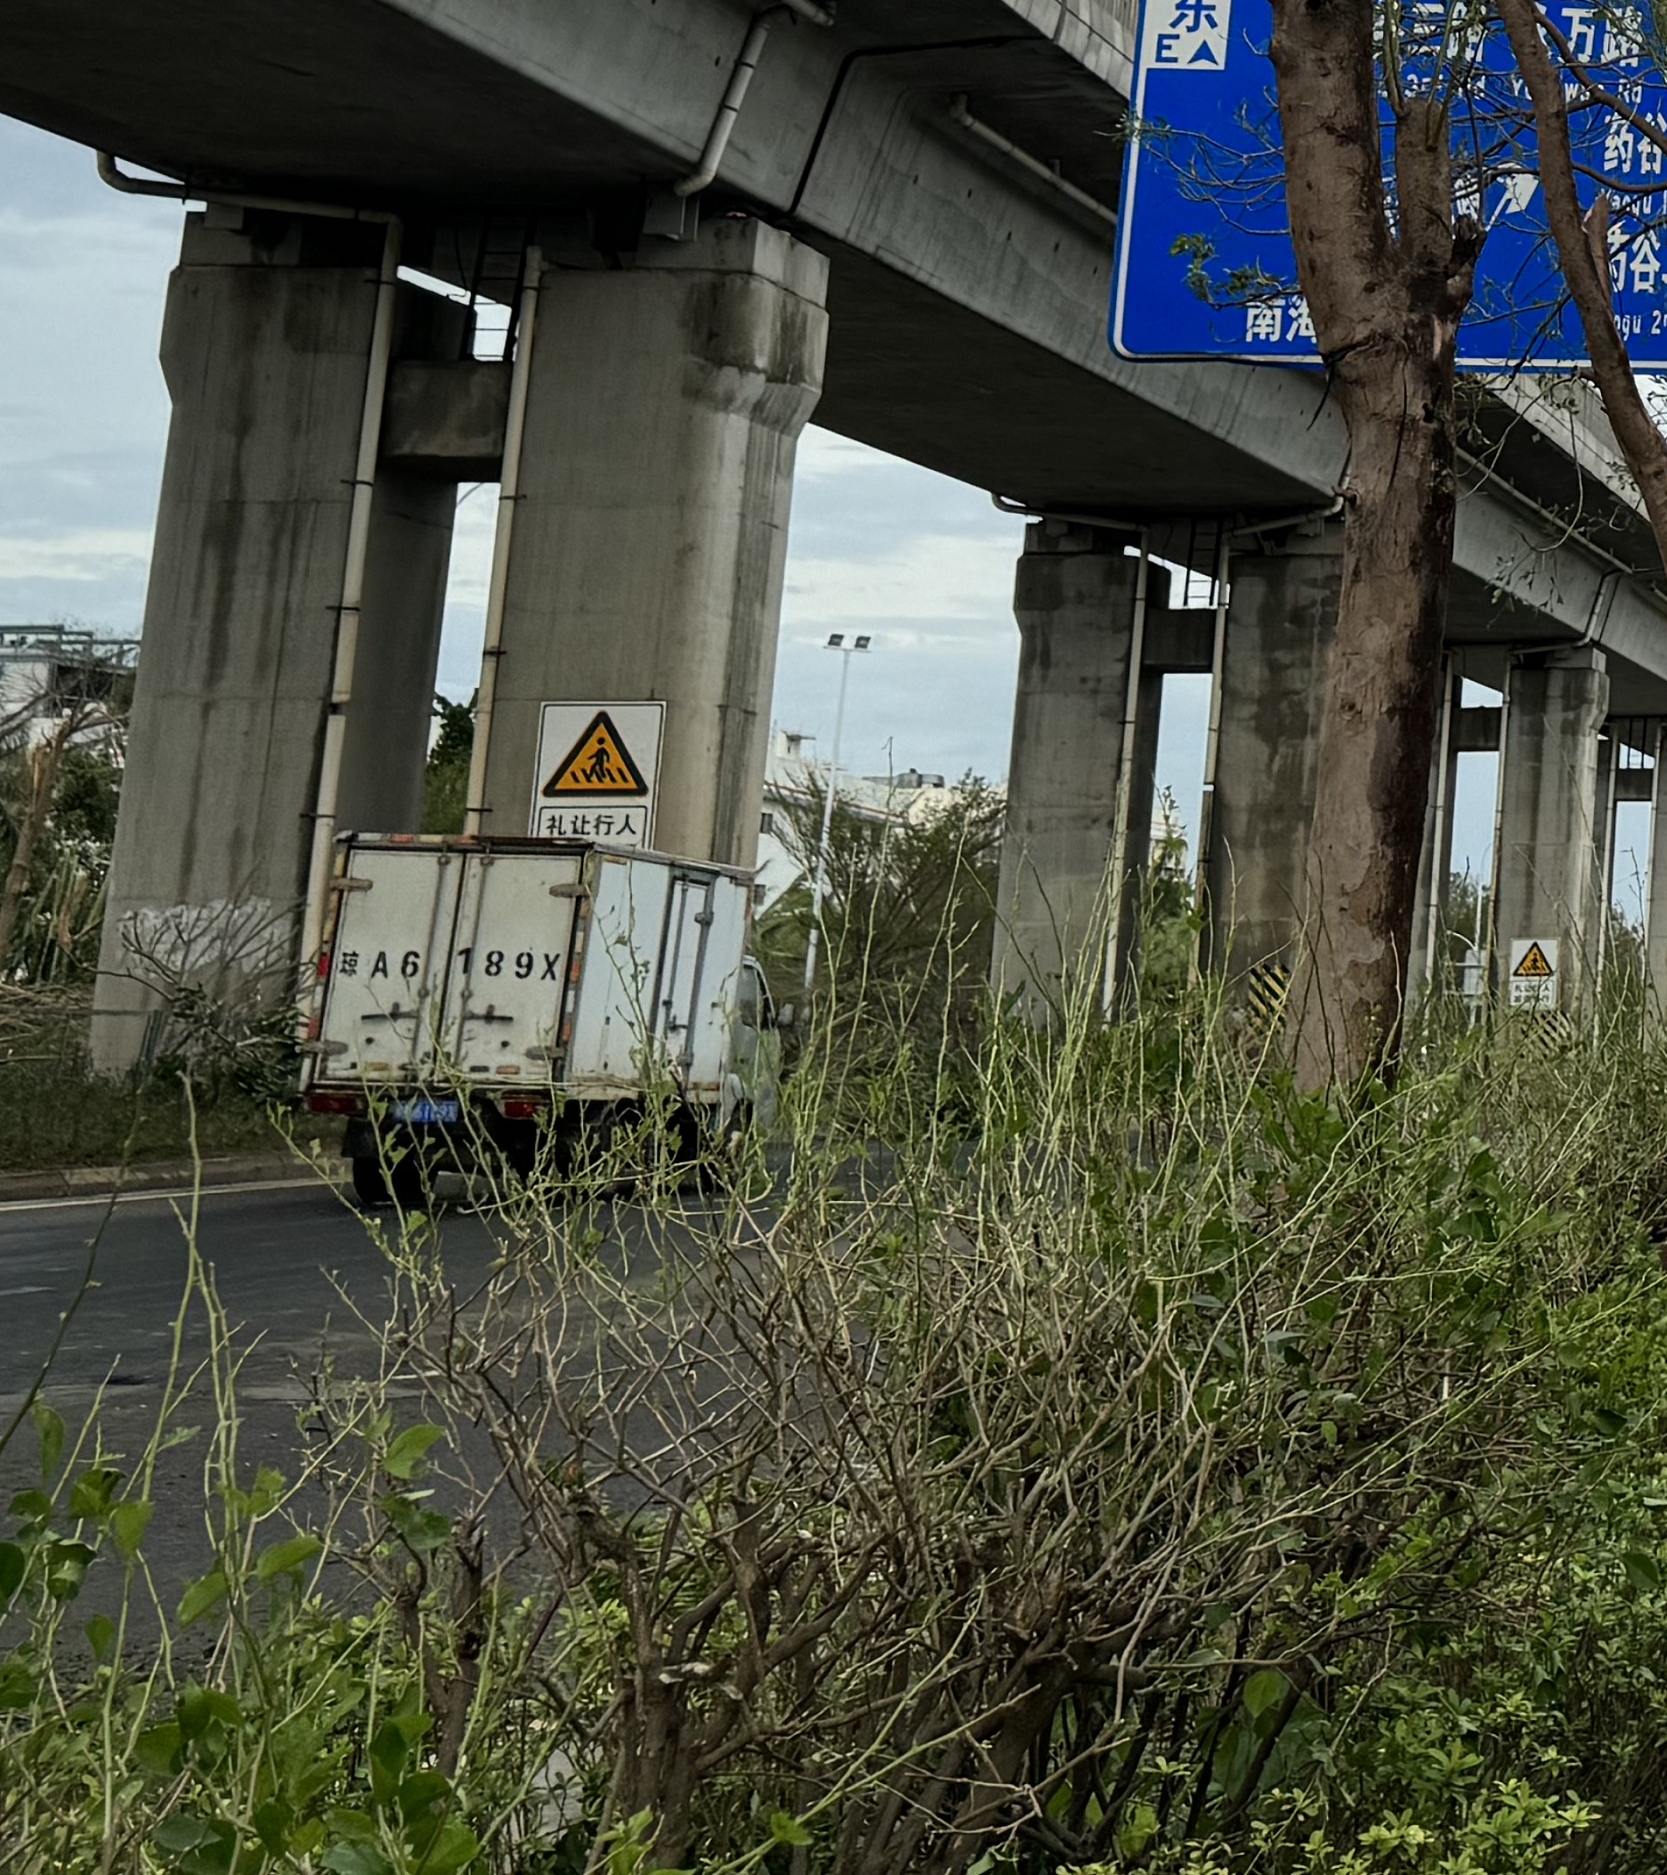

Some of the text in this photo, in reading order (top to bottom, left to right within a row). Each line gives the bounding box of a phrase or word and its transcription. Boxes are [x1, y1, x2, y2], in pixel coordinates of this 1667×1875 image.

[1155, 34, 1180, 63] E
[546, 814, 637, 836] 礼让行人
